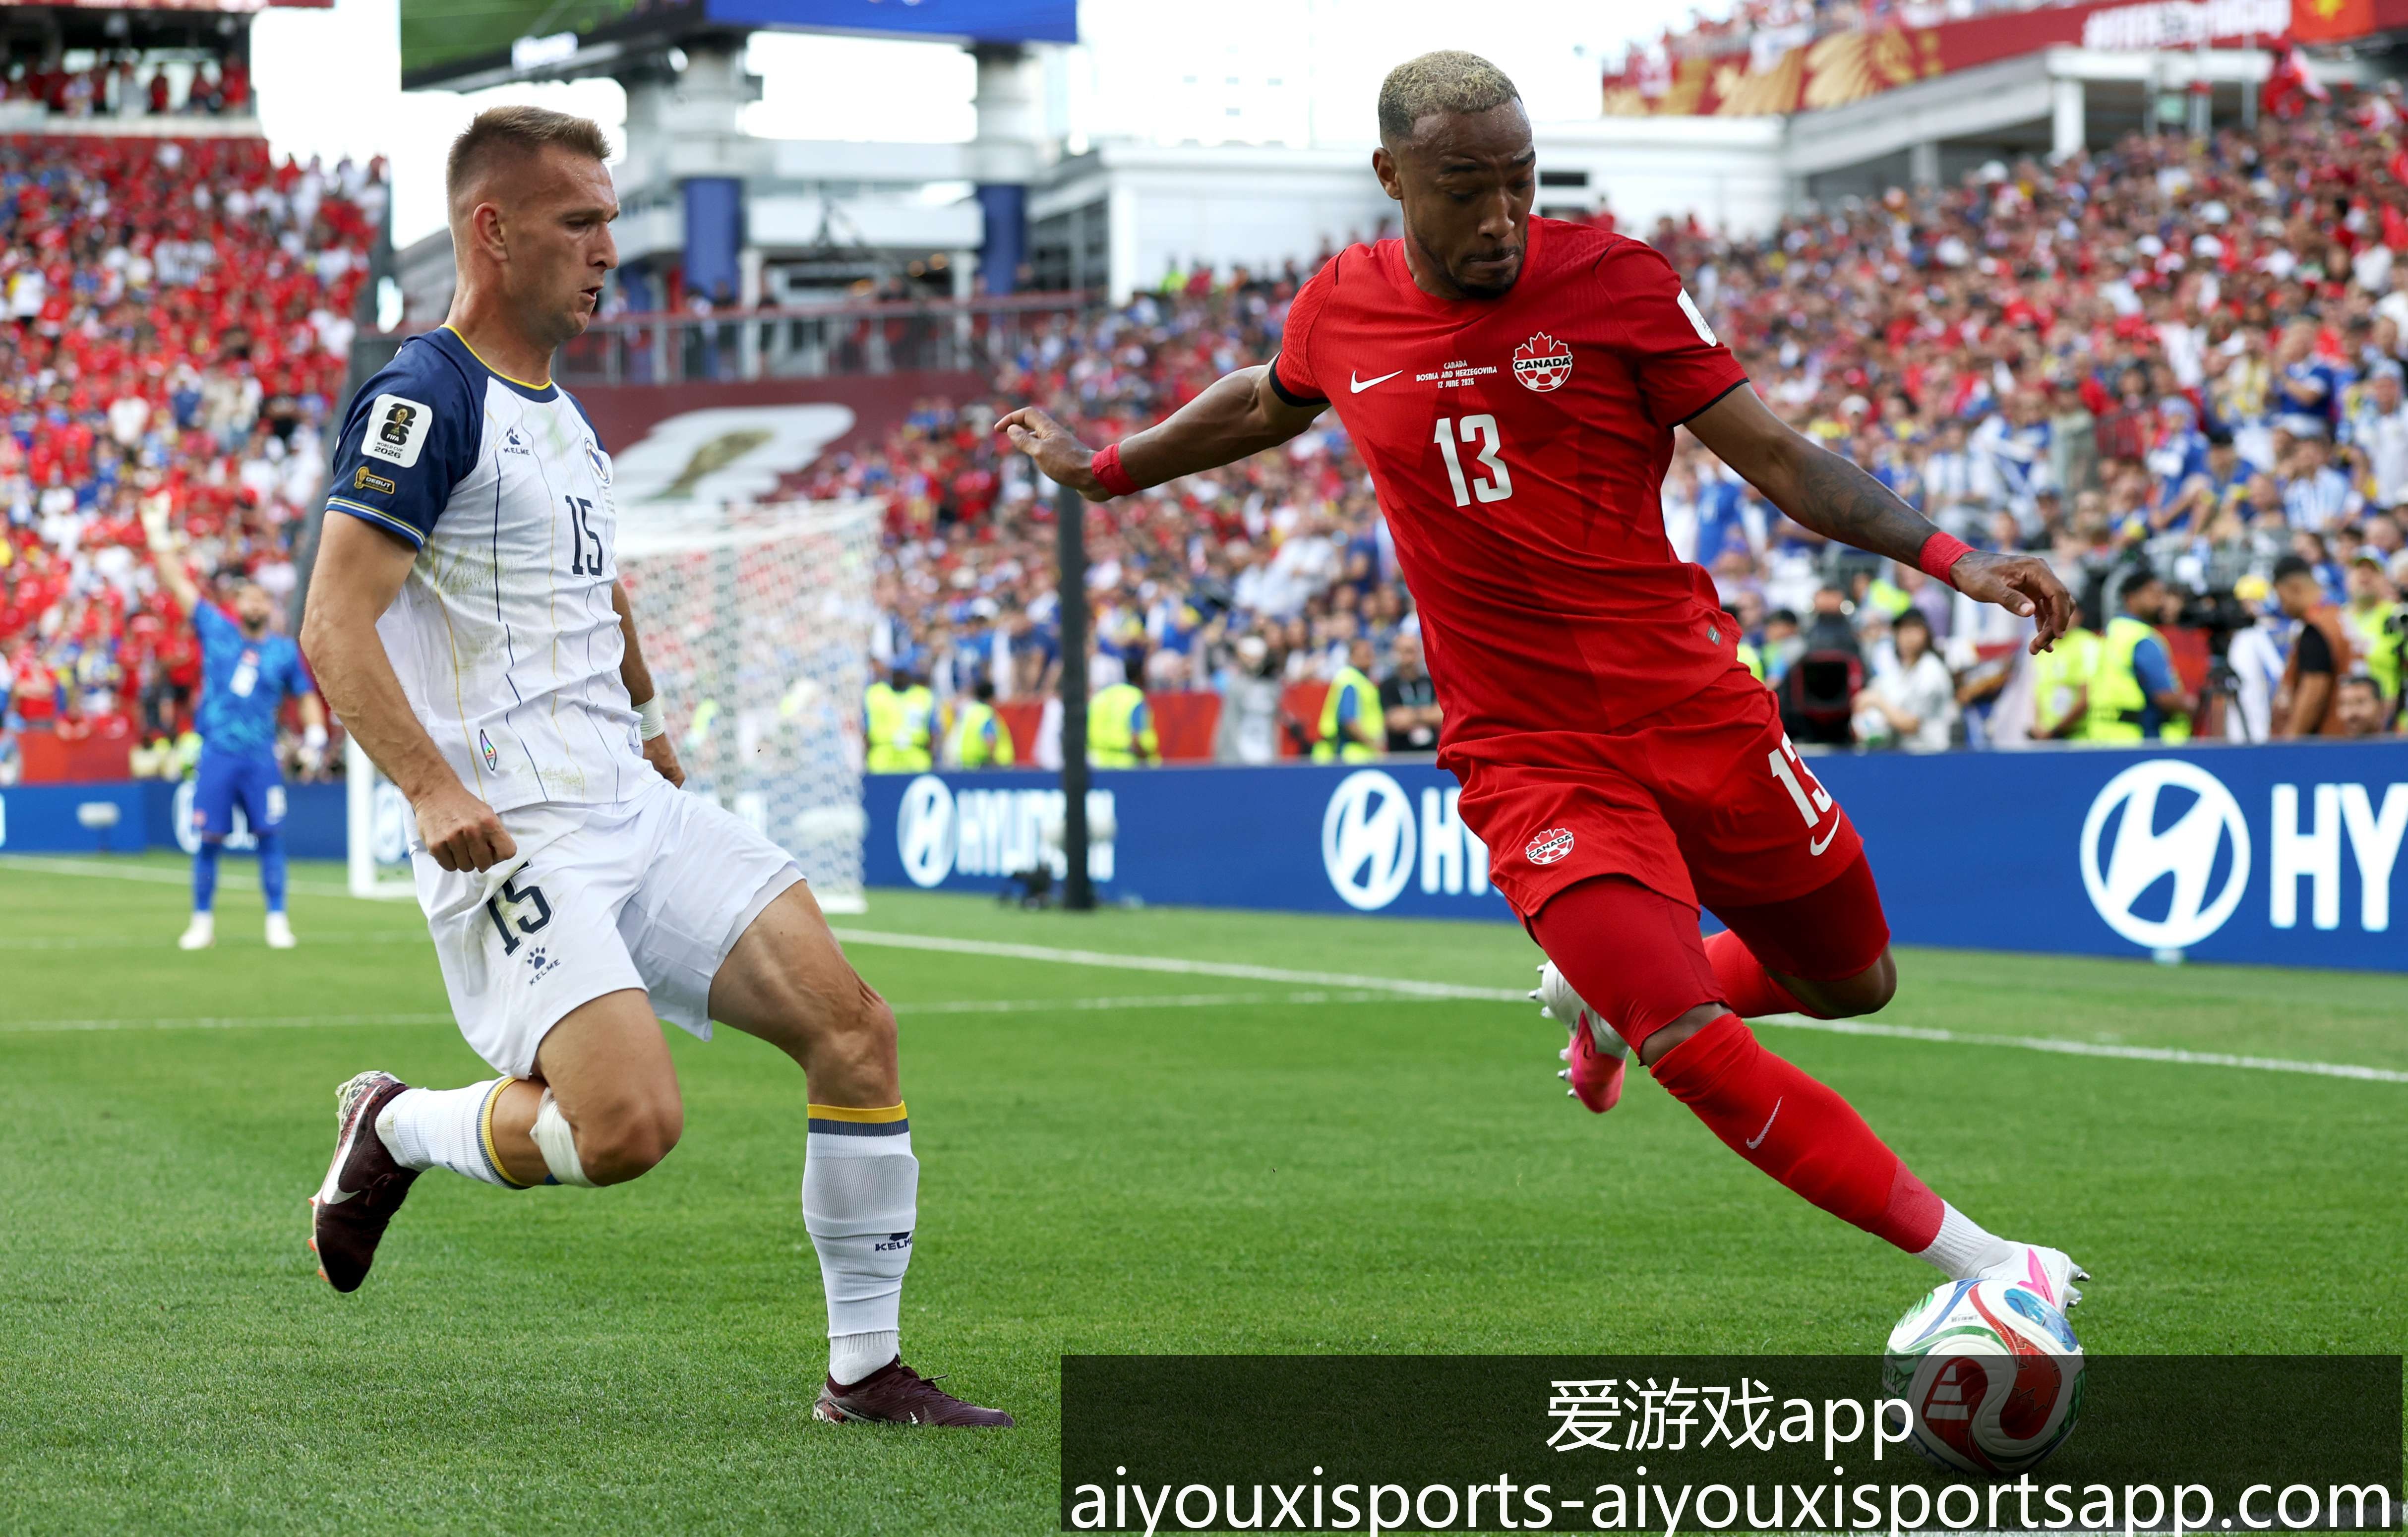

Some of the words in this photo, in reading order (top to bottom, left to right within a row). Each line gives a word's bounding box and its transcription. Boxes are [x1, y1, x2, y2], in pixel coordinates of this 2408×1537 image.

[1444, 359, 1468, 369] CANADA
[1514, 357, 1570, 370] CANADA
[1416, 372, 1439, 382] BOSNIA
[1455, 366, 1498, 377] HERZEGOVINA
[1445, 379, 1459, 388] JUNE
[1461, 378, 1475, 386] 2026
[386, 433, 399, 442] FIFA
[374, 446, 401, 459] 2026
[1434, 414, 1513, 507] 13
[365, 477, 392, 487] DEBUT
[565, 495, 603, 577] 15
[1529, 835, 1571, 858] CANADA
[2270, 782, 2408, 932] HY
[486, 859, 554, 956] 15
[529, 958, 561, 986] KELME
